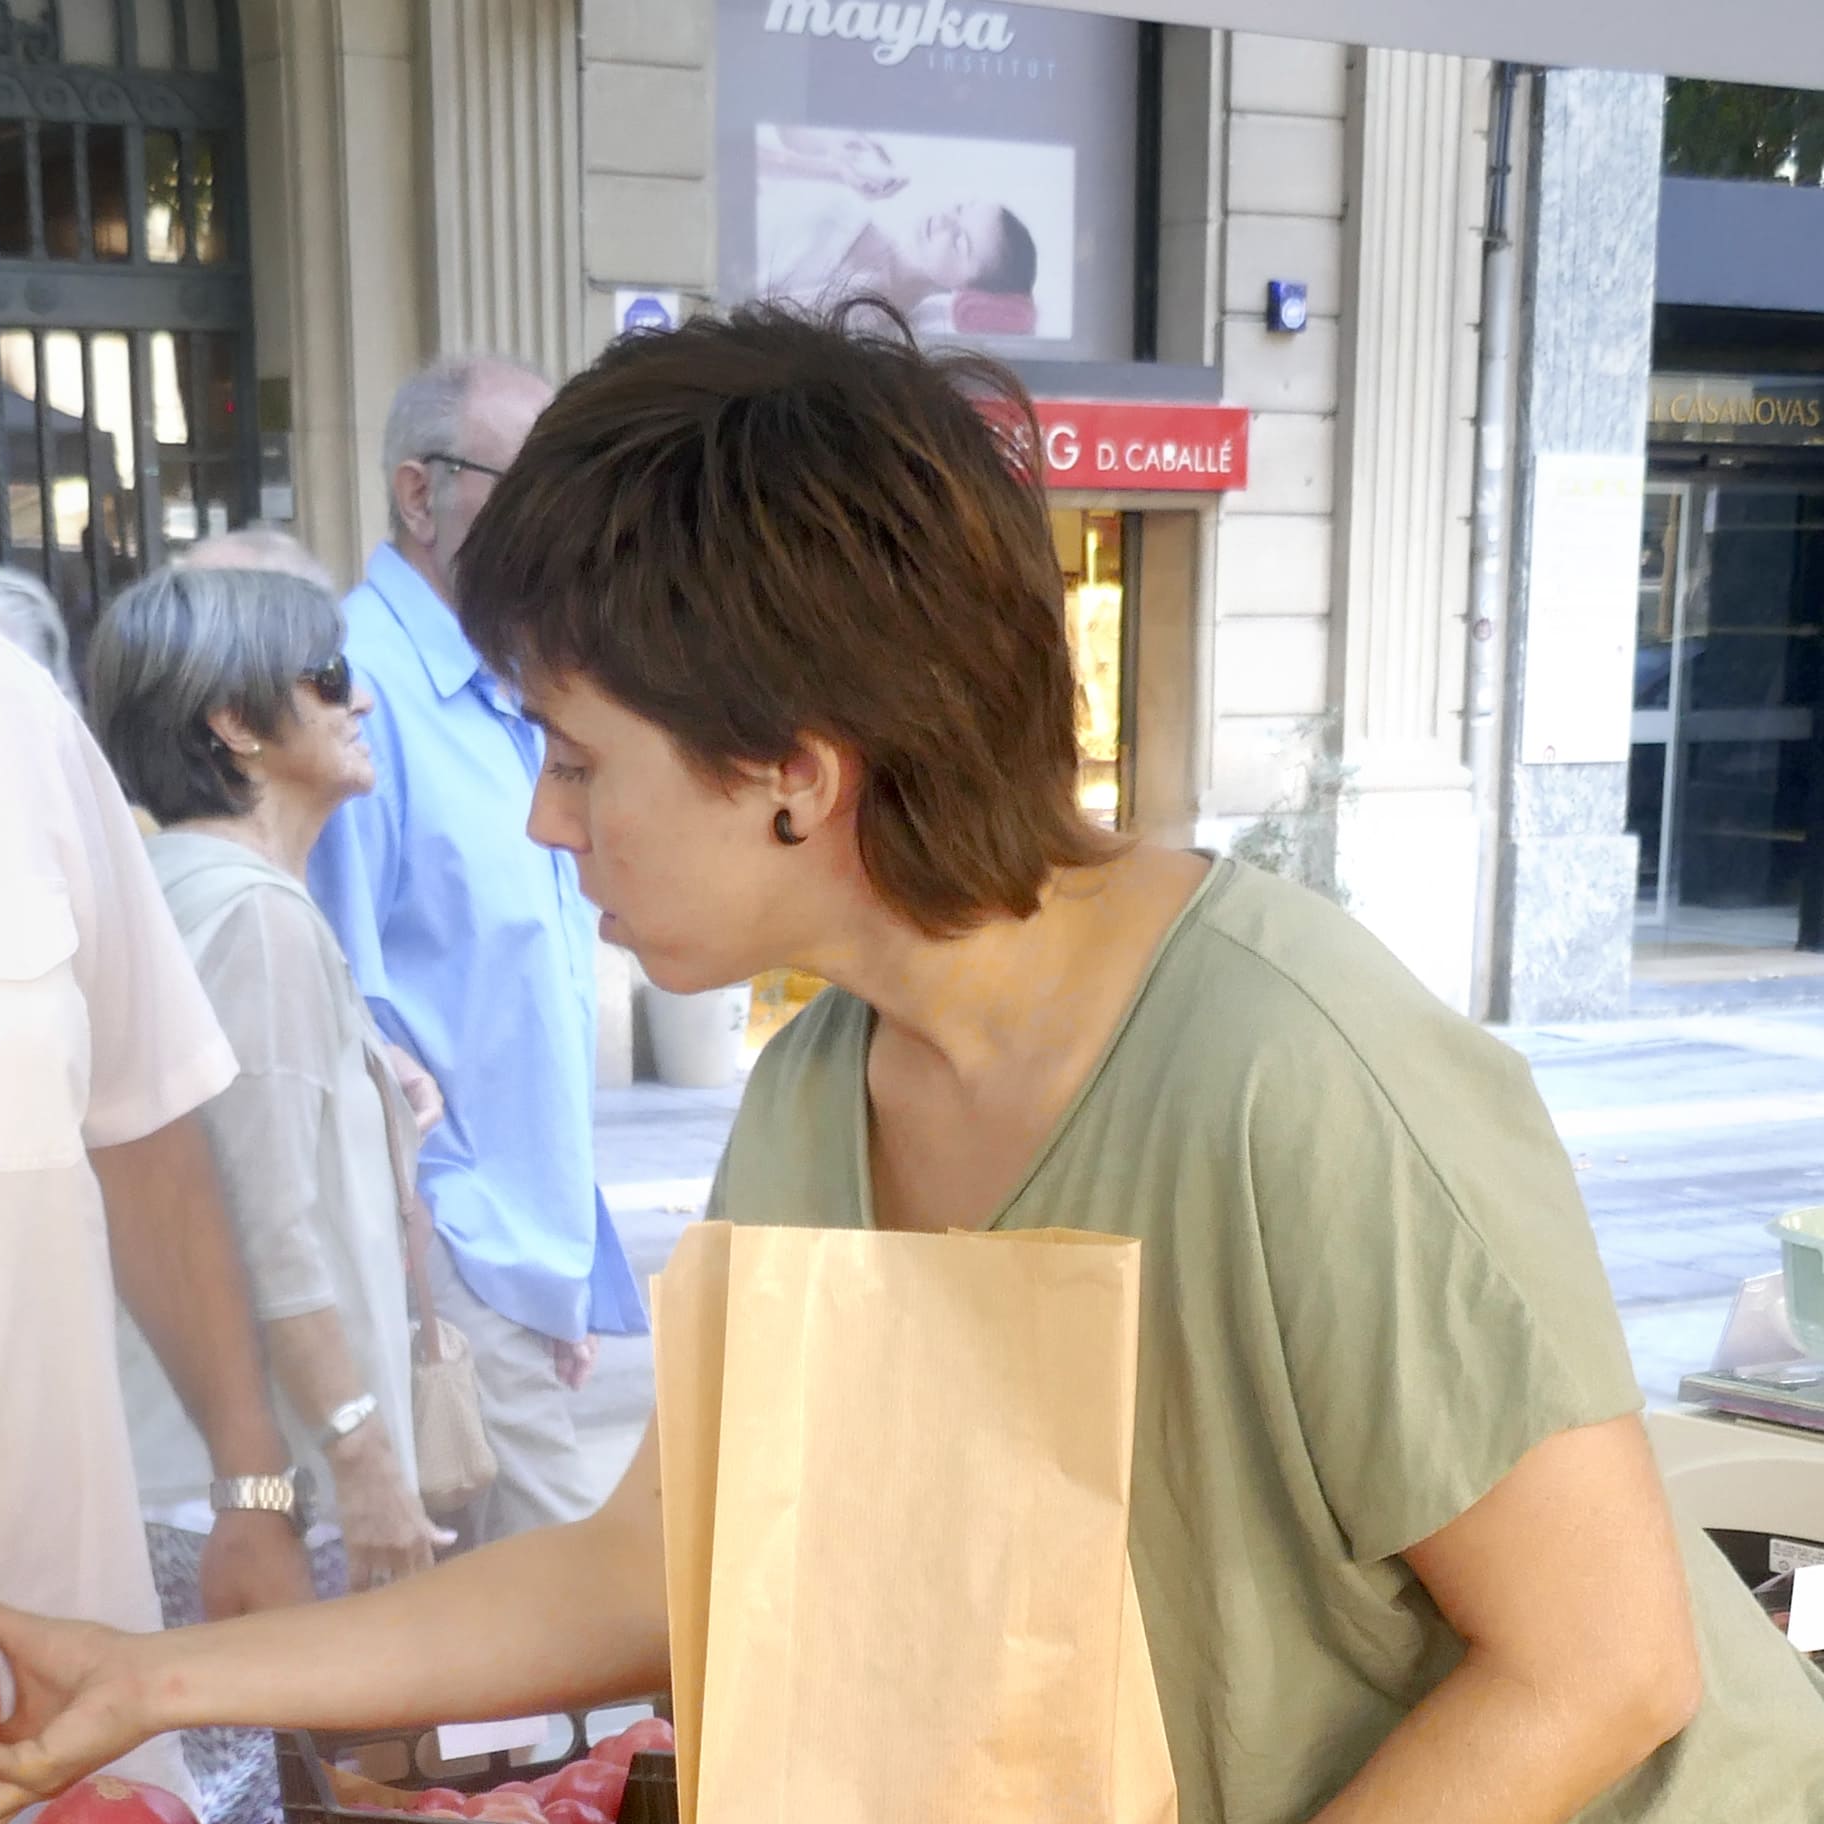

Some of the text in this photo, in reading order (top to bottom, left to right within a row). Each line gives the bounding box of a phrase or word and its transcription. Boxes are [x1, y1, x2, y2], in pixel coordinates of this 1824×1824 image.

[764, 0, 1015, 66] mayka
[928, 52, 1057, 80] INSTITUT
[1670, 396, 1822, 427] CASANOVAS
[1097, 443, 1119, 471] D.
[1126, 438, 1232, 473] CABALLÉ
